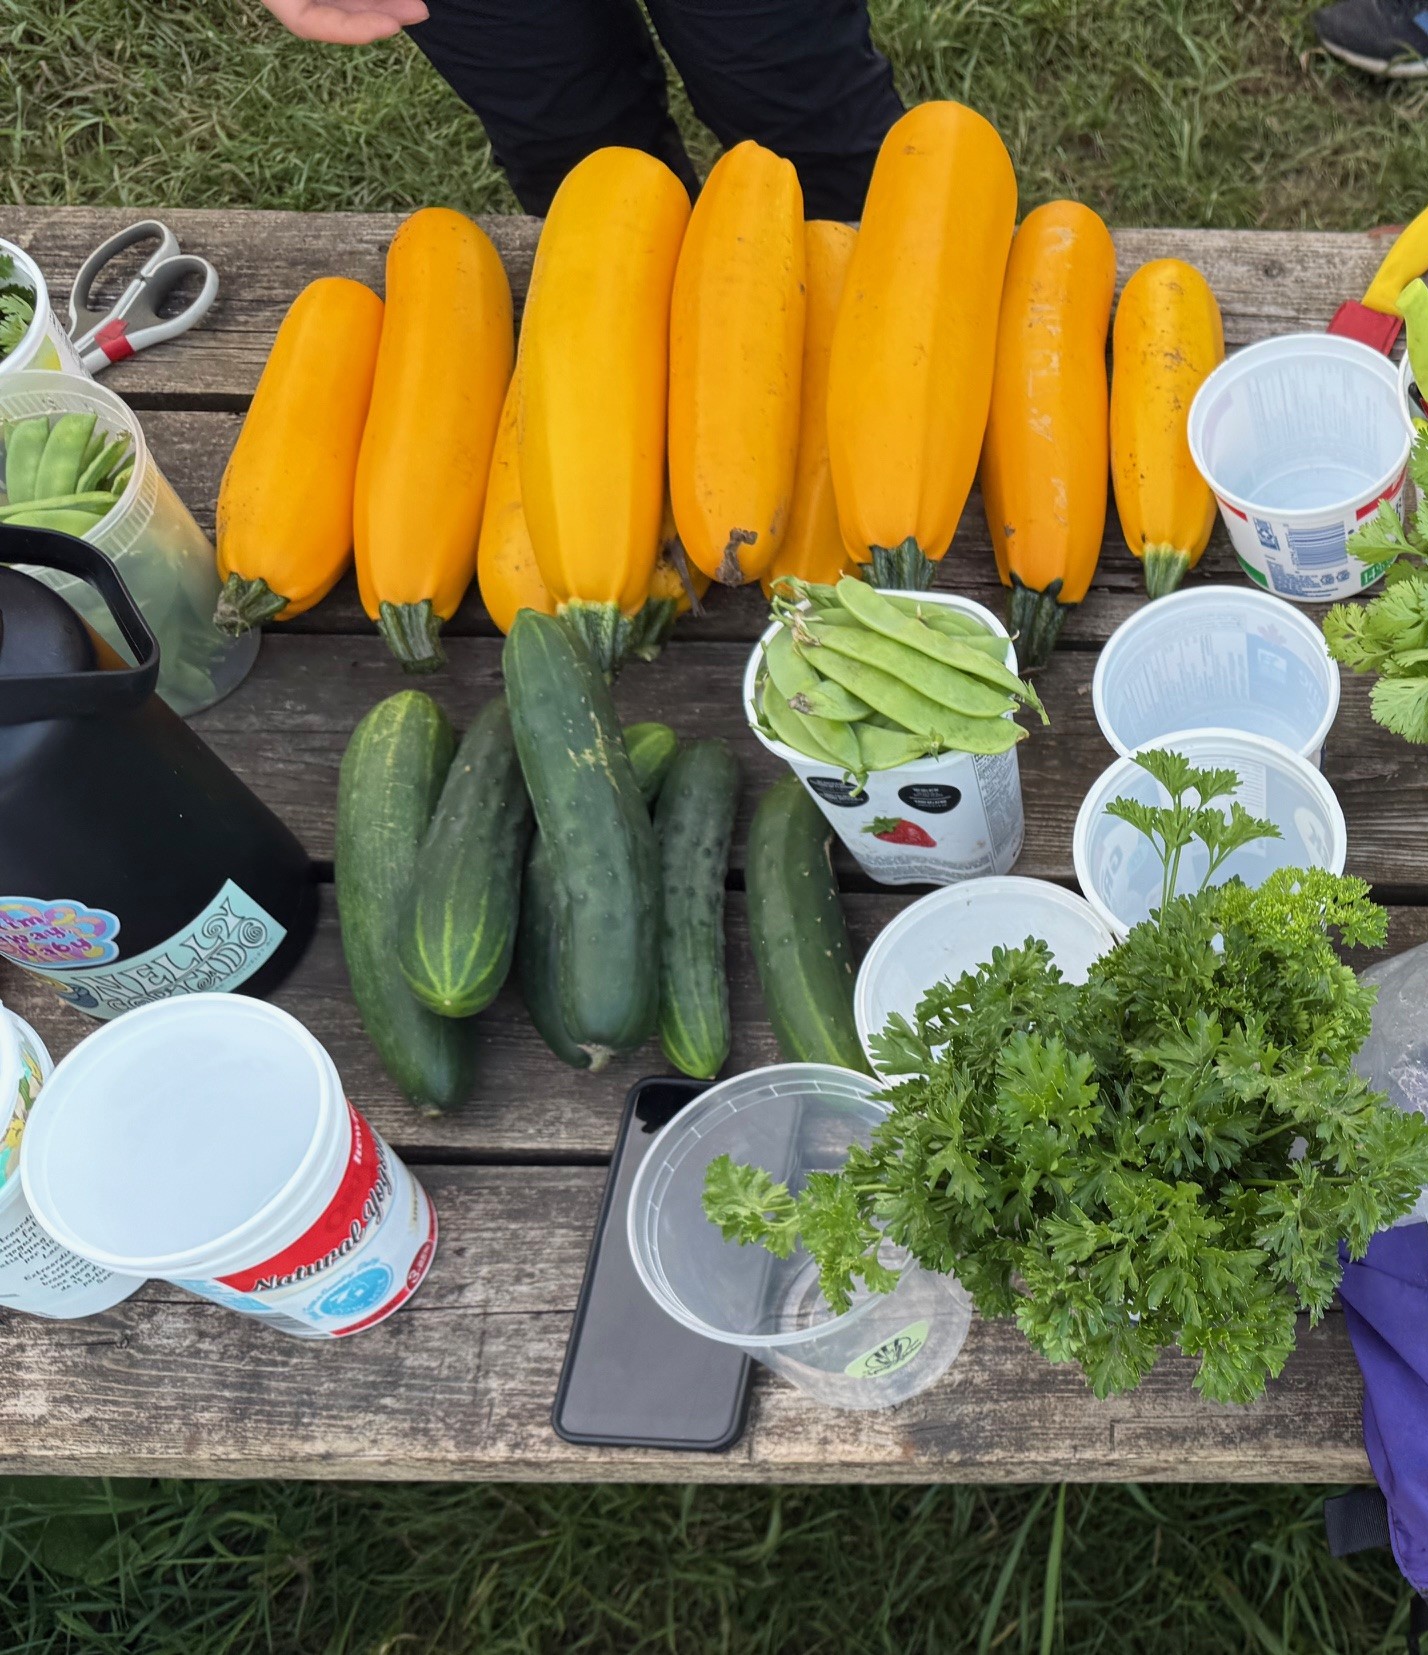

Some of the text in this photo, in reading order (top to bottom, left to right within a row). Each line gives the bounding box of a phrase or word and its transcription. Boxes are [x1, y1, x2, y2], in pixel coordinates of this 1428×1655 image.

[19, 936, 92, 957] baby
[70, 896, 245, 1002] NELLY
[250, 1219, 362, 1293] Natural
